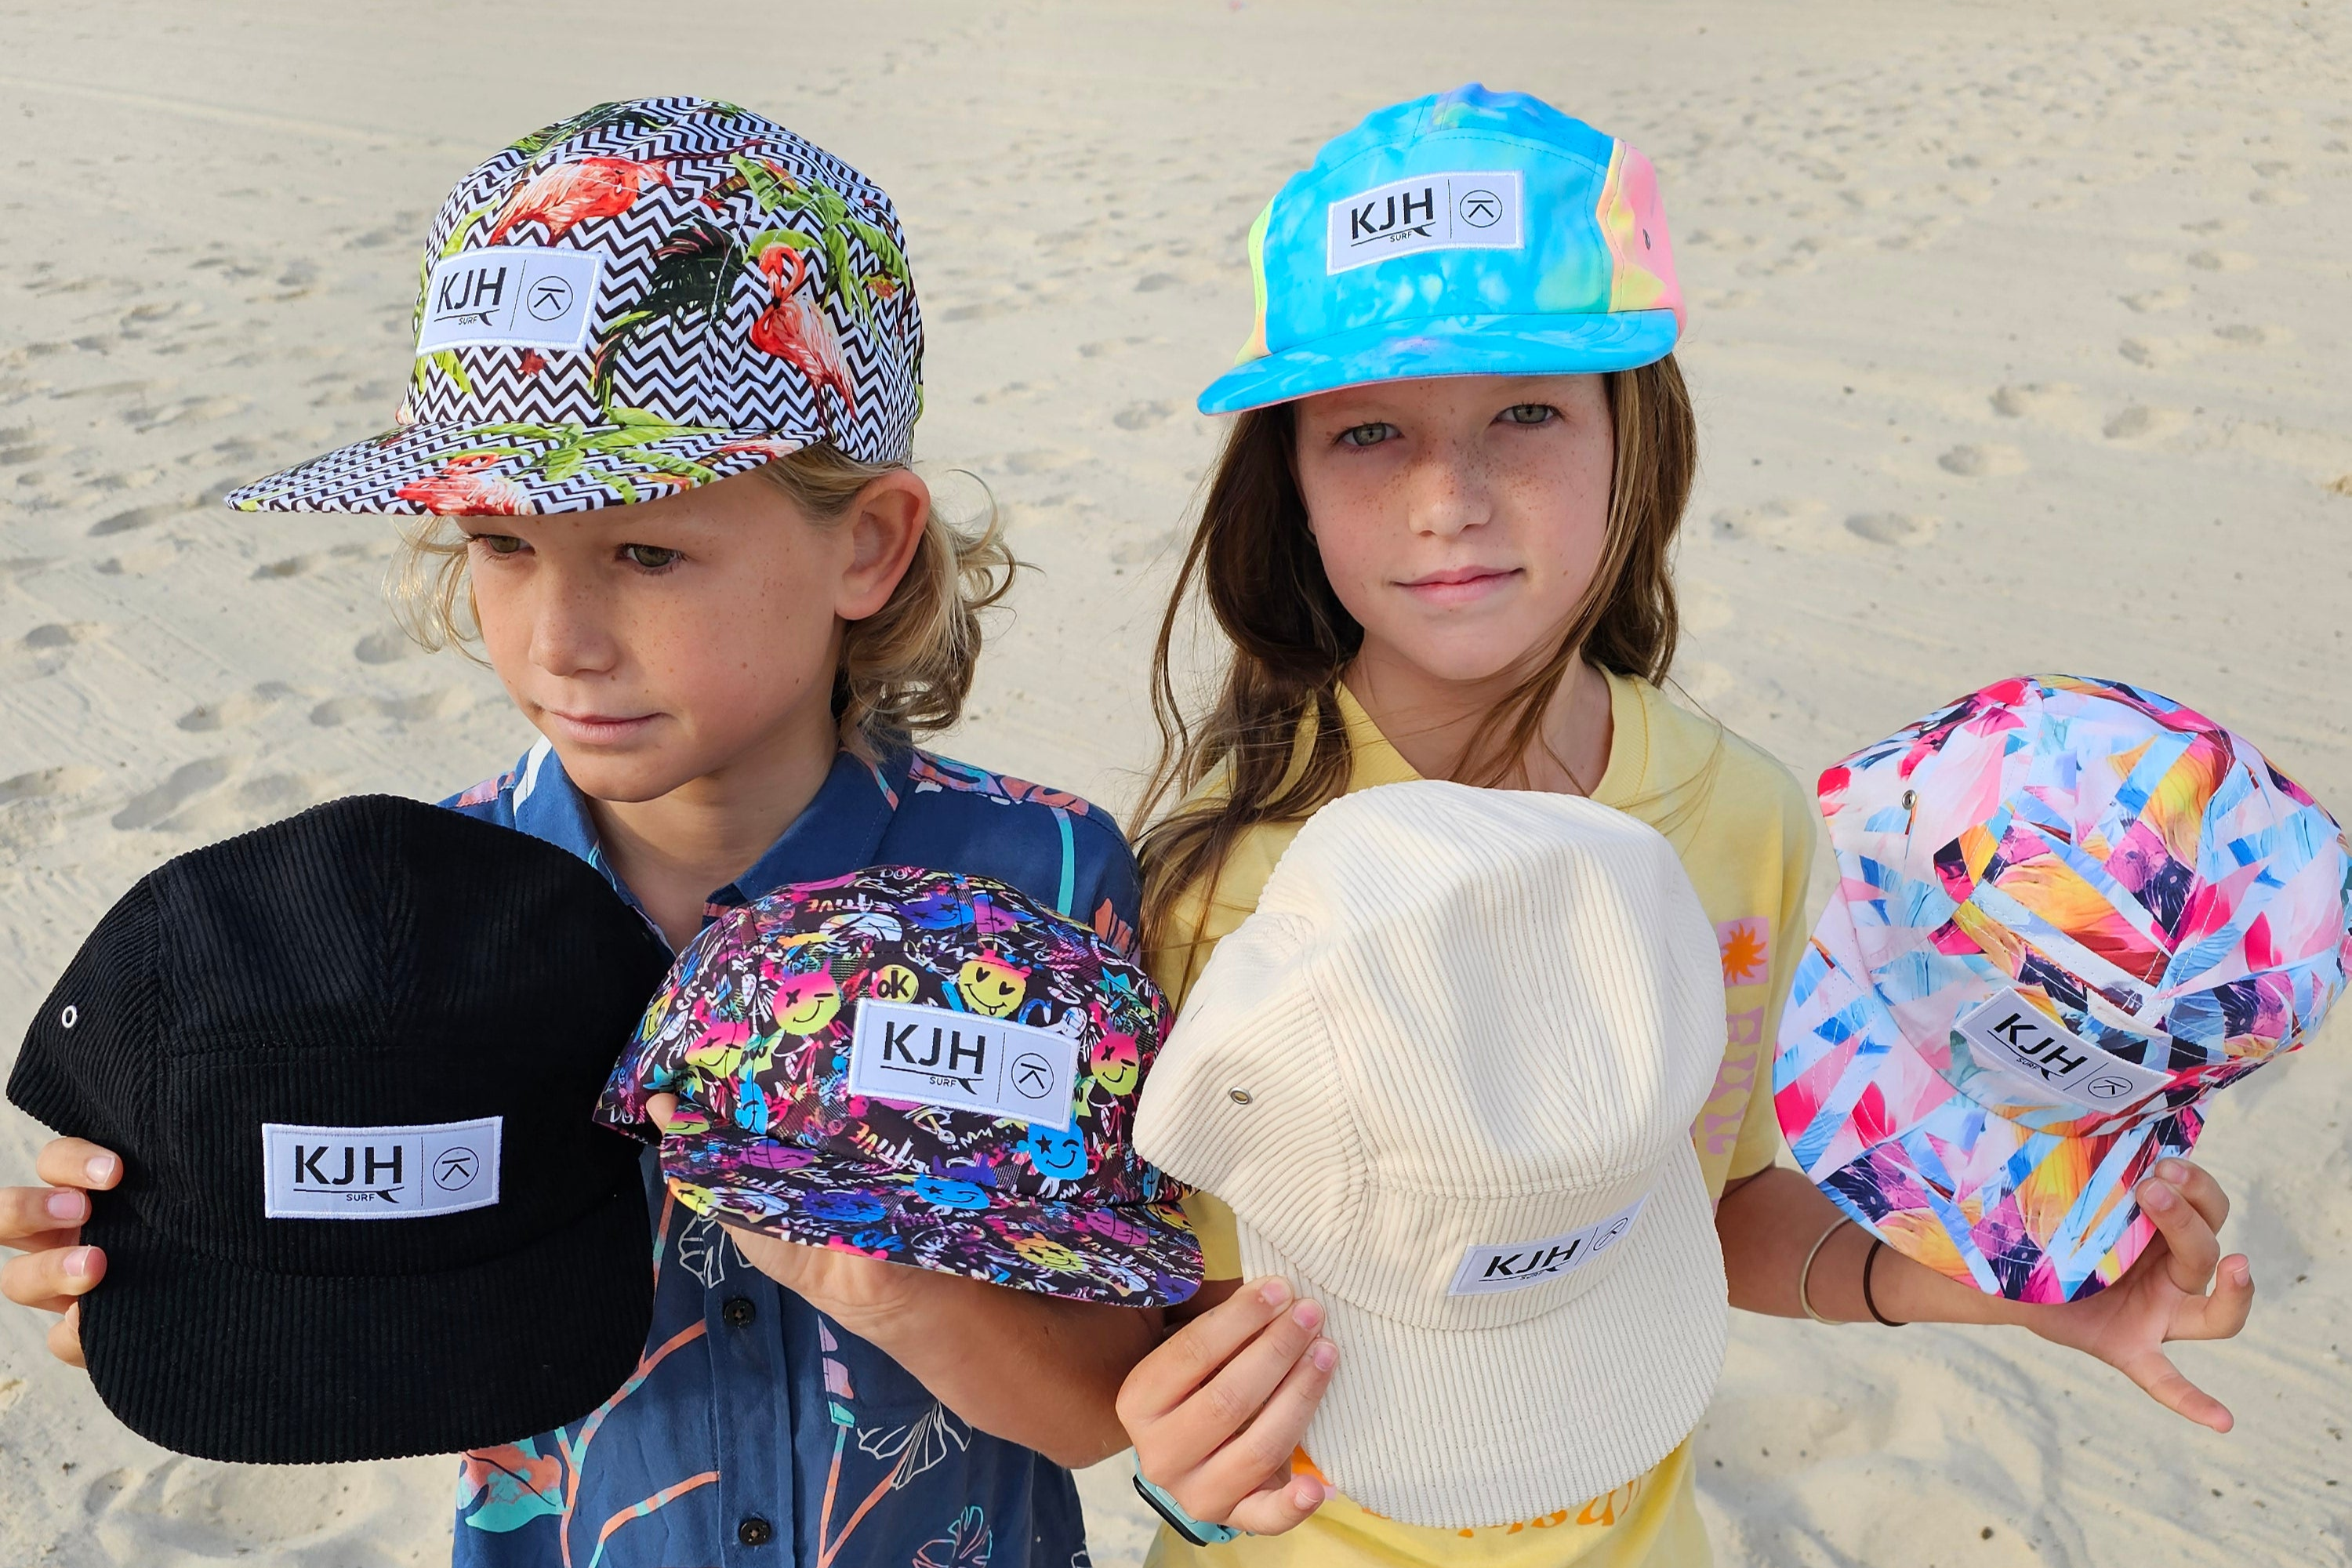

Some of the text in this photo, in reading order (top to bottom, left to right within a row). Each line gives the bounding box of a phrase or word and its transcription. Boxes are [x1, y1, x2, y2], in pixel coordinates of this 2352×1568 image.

[1351, 187, 1434, 240] KJH
[1390, 231, 1411, 242] SURF
[437, 267, 506, 314] KJH
[458, 316, 477, 325] SURF
[883, 1021, 986, 1075] KJH
[1993, 1012, 2089, 1075] KJH
[929, 1076, 956, 1087] SURF
[295, 1145, 402, 1185] KJH
[346, 1193, 376, 1202] SURF
[1483, 1238, 1581, 1278] KJH
